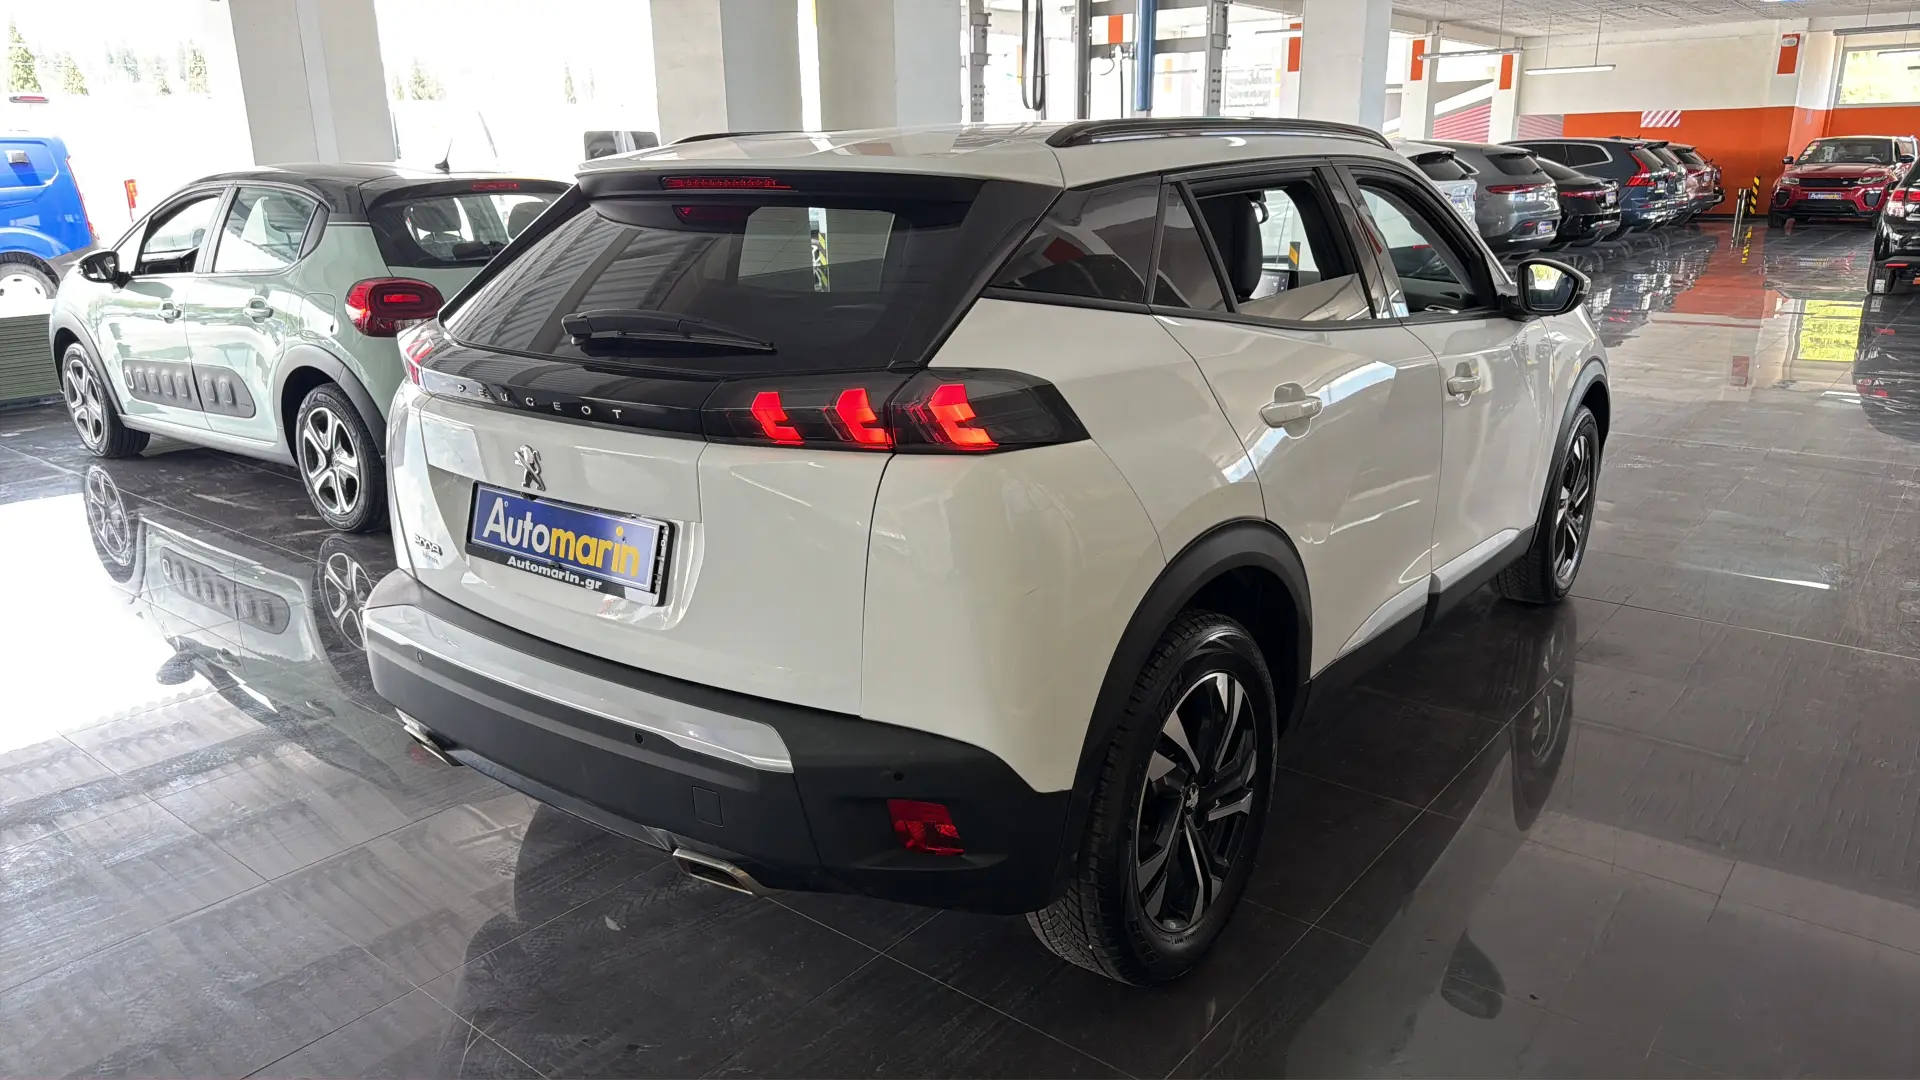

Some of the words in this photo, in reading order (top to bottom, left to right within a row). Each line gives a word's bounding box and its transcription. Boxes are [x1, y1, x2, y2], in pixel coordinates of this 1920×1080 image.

[457, 384, 622, 419] PEUGEOT
[482, 497, 640, 577] Automarin
[507, 556, 603, 590] Automarin.gr
